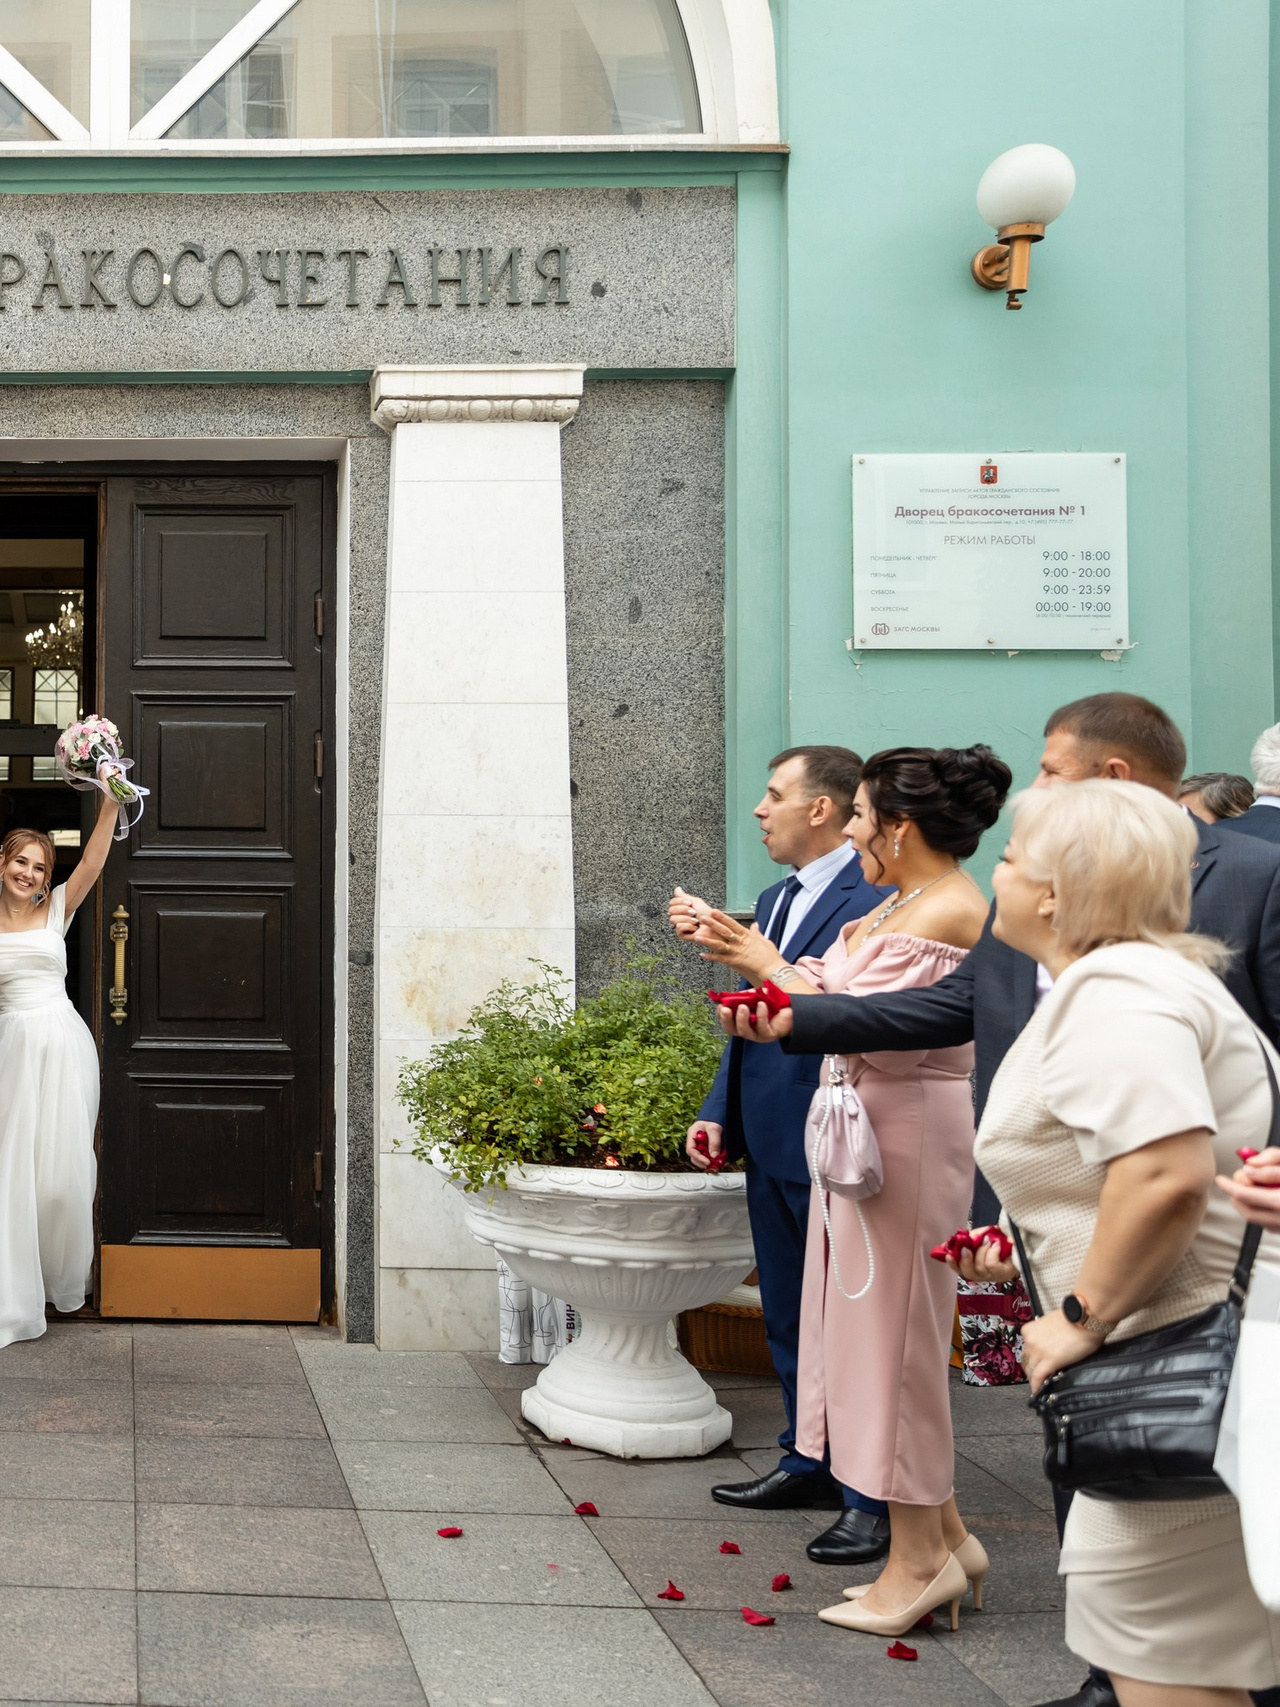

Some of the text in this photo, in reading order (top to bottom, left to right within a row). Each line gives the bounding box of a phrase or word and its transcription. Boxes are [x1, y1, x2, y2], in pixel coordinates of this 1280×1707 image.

[894, 505, 1085, 519] Дворец бракосочетания № 1
[944, 535, 1036, 546] РЕЖИМ РАБОТЫ
[1042, 551, 1069, 562] 9:00
[1080, 551, 1111, 562] 18:00
[1042, 568, 1069, 578] 9:00
[1078, 567, 1111, 578] 20:00
[1043, 585, 1069, 595] 9:00
[1078, 584, 1111, 595] 23:59
[1035, 601, 1069, 612] 00:00
[1081, 601, 1111, 612] 19:00
